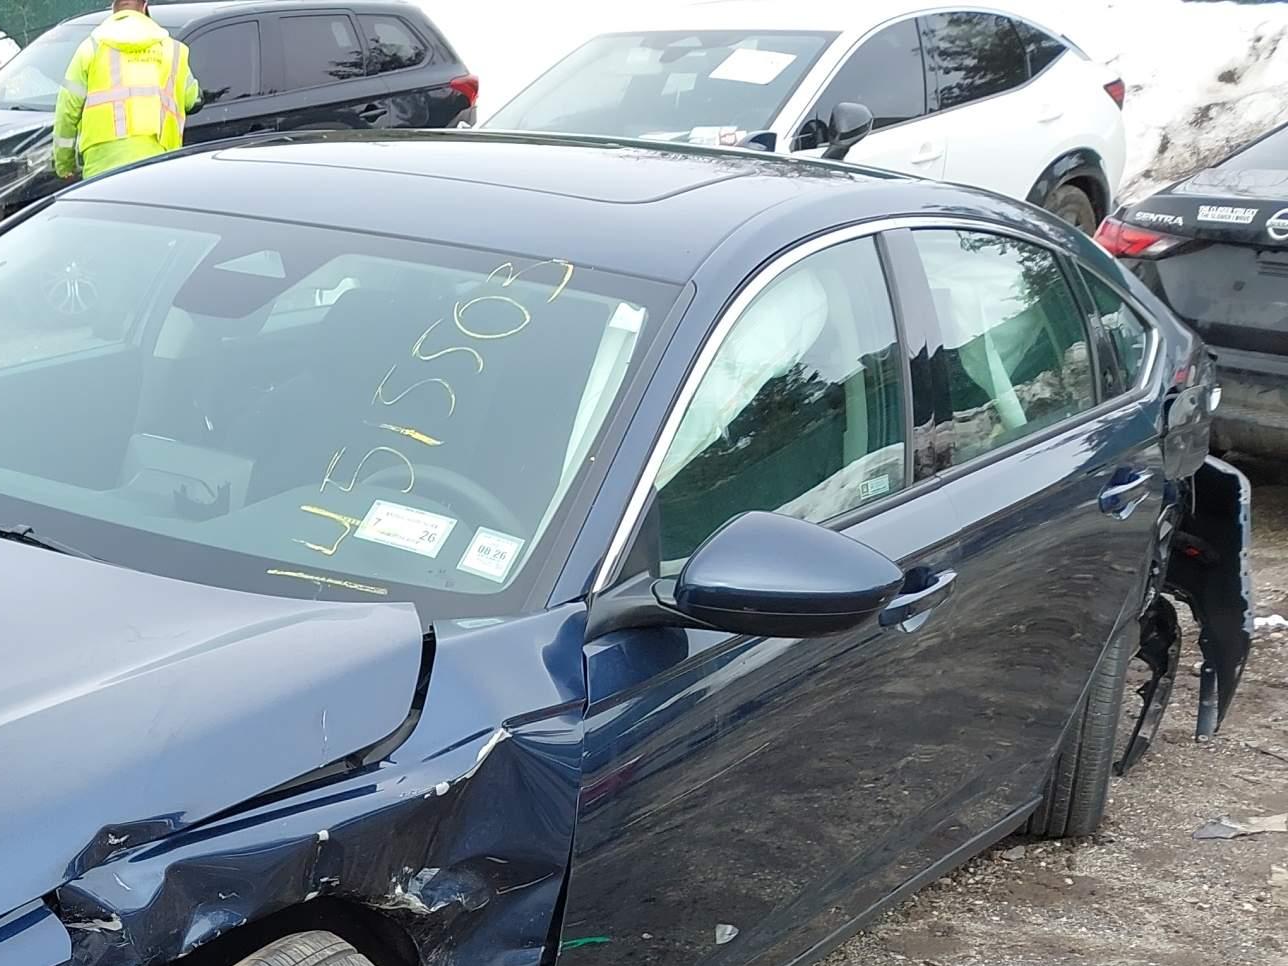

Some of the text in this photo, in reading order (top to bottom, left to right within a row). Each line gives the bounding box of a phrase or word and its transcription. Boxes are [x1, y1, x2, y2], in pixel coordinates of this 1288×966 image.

[1135, 211, 1184, 227] SENTRA
[419, 529, 437, 544] 26
[494, 547, 508, 561] 26
